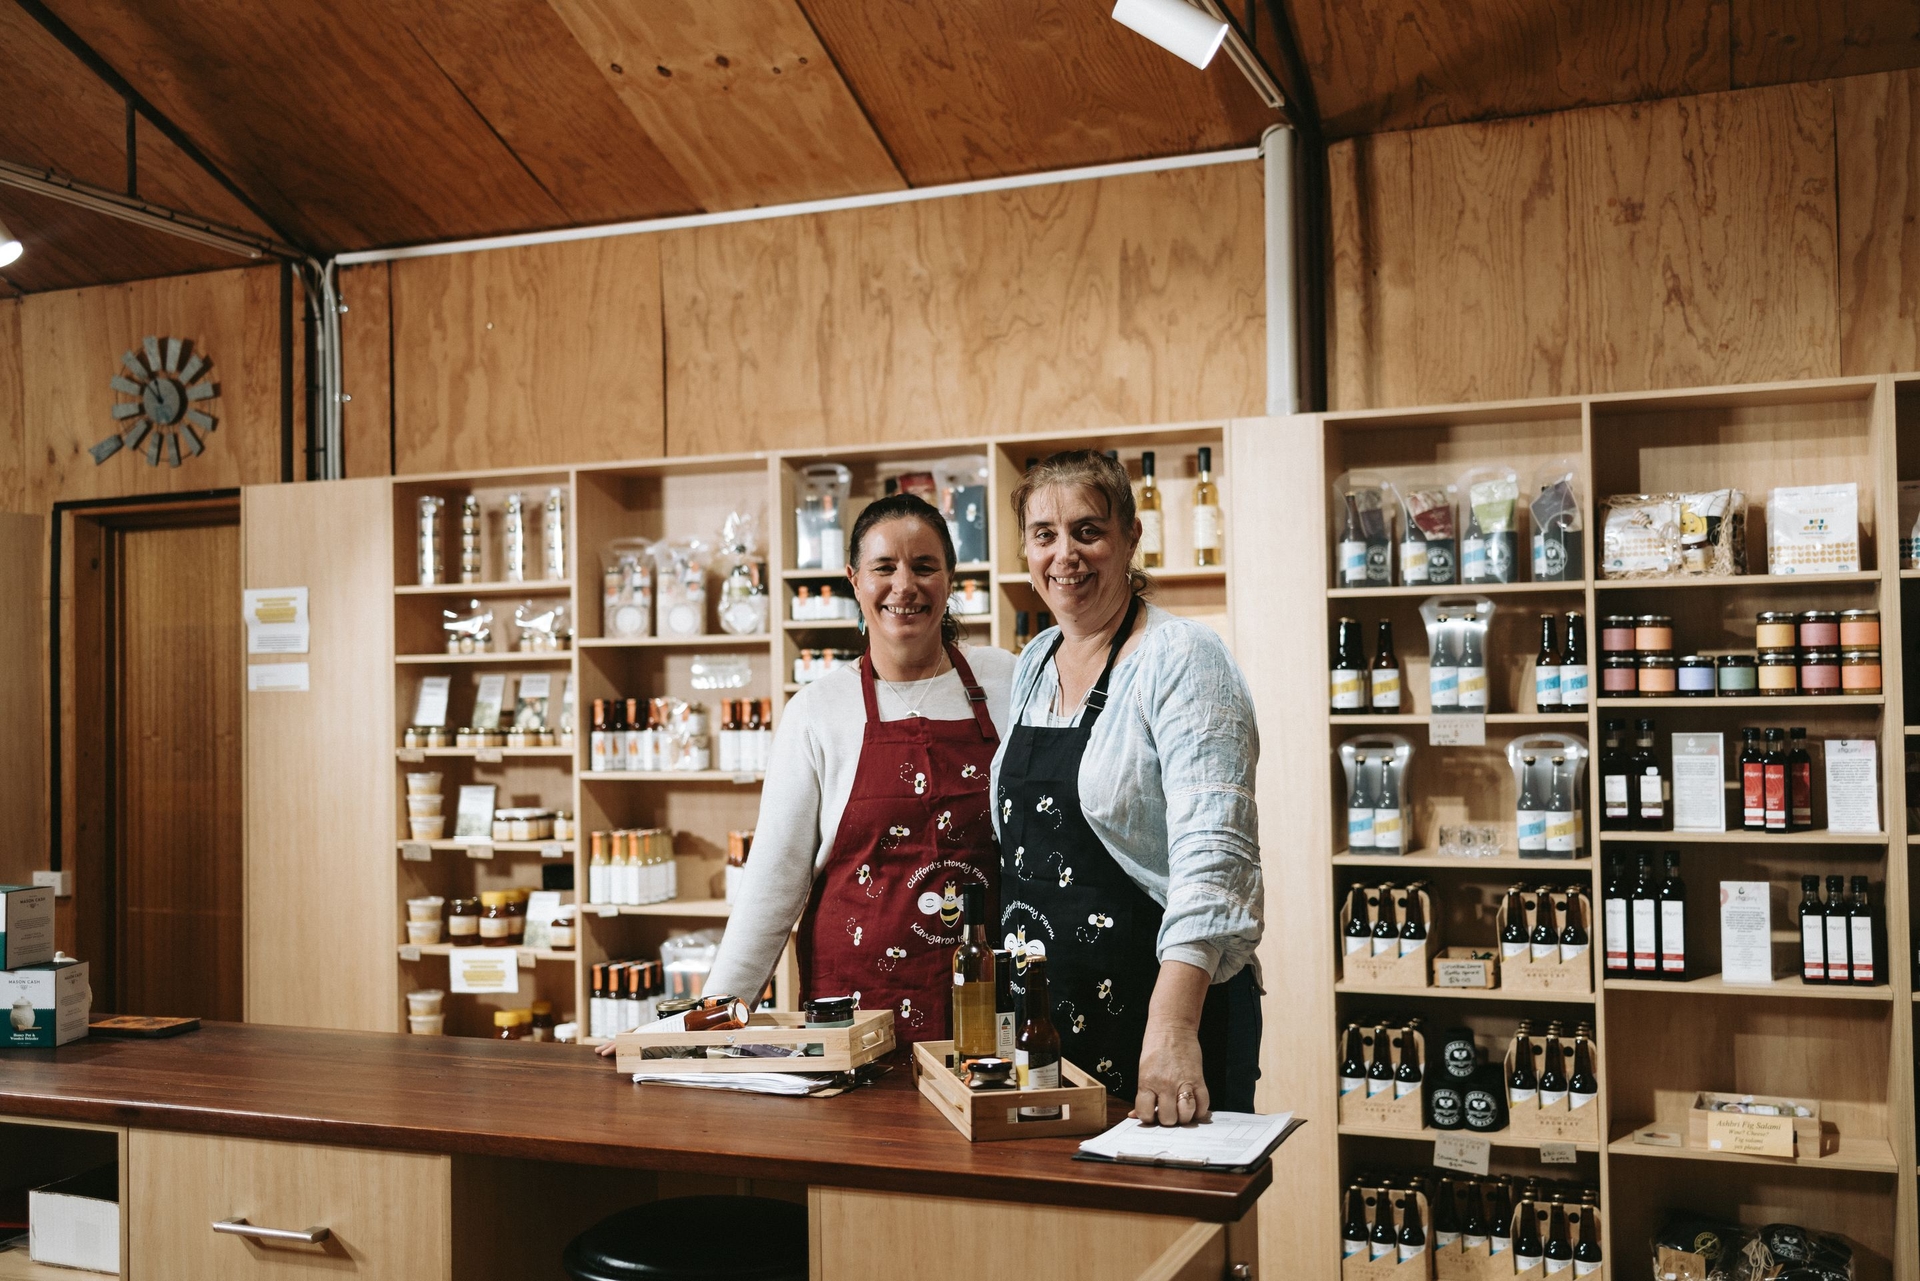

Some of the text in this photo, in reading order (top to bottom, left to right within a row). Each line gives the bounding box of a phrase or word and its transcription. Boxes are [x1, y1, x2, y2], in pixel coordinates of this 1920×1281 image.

[907, 860, 990, 888] Clifford's Honey Farm
[910, 922, 954, 944] Kangaroo
[1039, 914, 1054, 940] Farm
[1742, 1121, 1754, 1129] Fig
[1756, 1122, 1781, 1130] Salami
